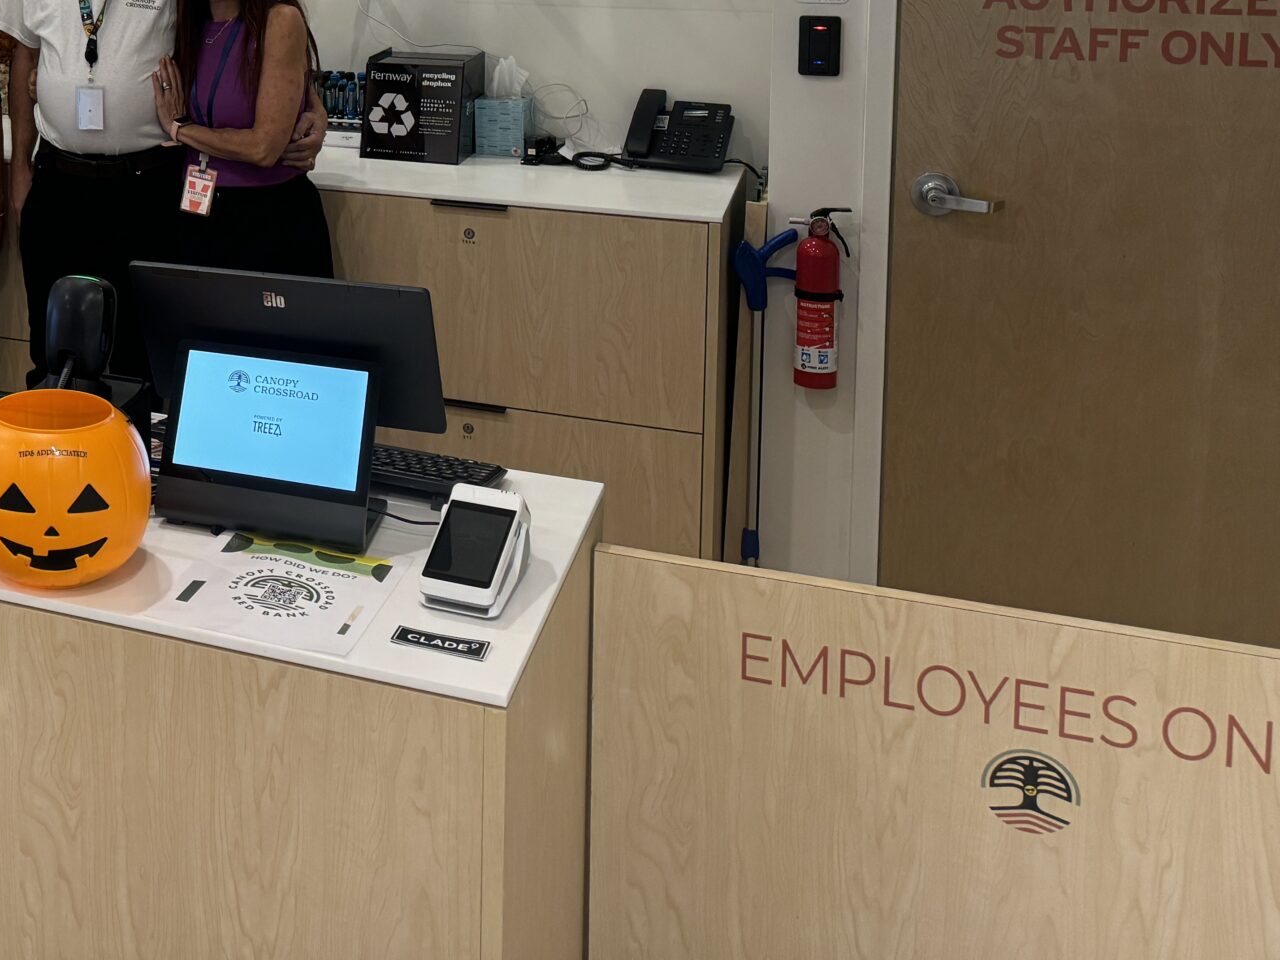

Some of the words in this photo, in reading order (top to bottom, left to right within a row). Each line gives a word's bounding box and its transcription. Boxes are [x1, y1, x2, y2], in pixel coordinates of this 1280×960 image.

[126, 2, 162, 11] CROSSROAD
[995, 26, 1149, 63] STAFF
[370, 70, 412, 83] Fernway
[422, 73, 456, 81] recycling
[255, 375, 299, 388] CANOPY
[254, 385, 319, 401] CROSSROAD
[36, 449, 88, 458] APPCIATED!
[284, 560, 306, 569] DID
[309, 567, 329, 575] WE
[332, 572, 358, 580] DO?
[228, 568, 275, 590] CANOPY
[285, 570, 336, 610] CROSSROAD
[232, 596, 255, 610] RED
[262, 610, 309, 618] BANK
[741, 631, 1139, 749] EMPLOYEES
